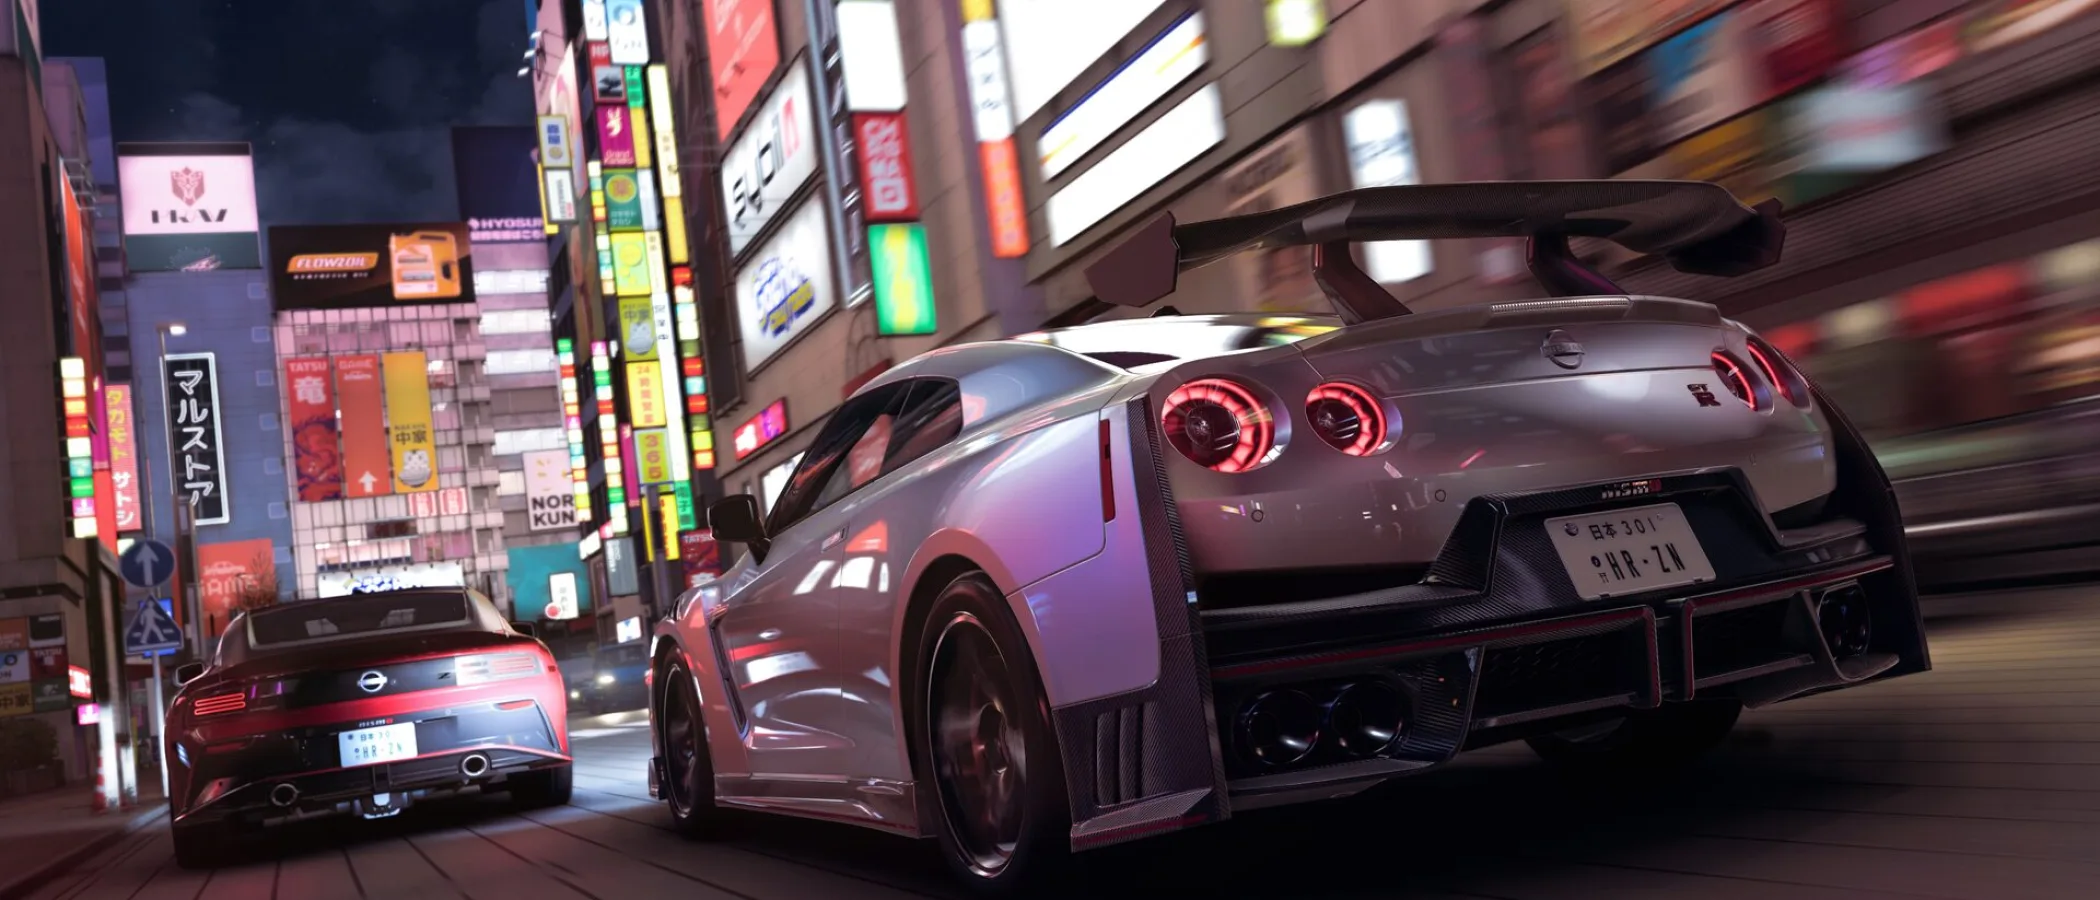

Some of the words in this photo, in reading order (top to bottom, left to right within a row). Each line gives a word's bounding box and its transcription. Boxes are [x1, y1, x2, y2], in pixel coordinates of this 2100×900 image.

[296, 255, 367, 270] FLOWZOIL
[289, 360, 327, 372] TATSU
[174, 370, 214, 505] マルストア
[396, 430, 427, 445] 中家
[645, 434, 662, 479] 365
[113, 471, 134, 526] サトシ
[532, 494, 574, 510] NOR
[534, 511, 575, 527] KUN
[1588, 521, 1618, 541] 日本
[1620, 518, 1657, 536] 301
